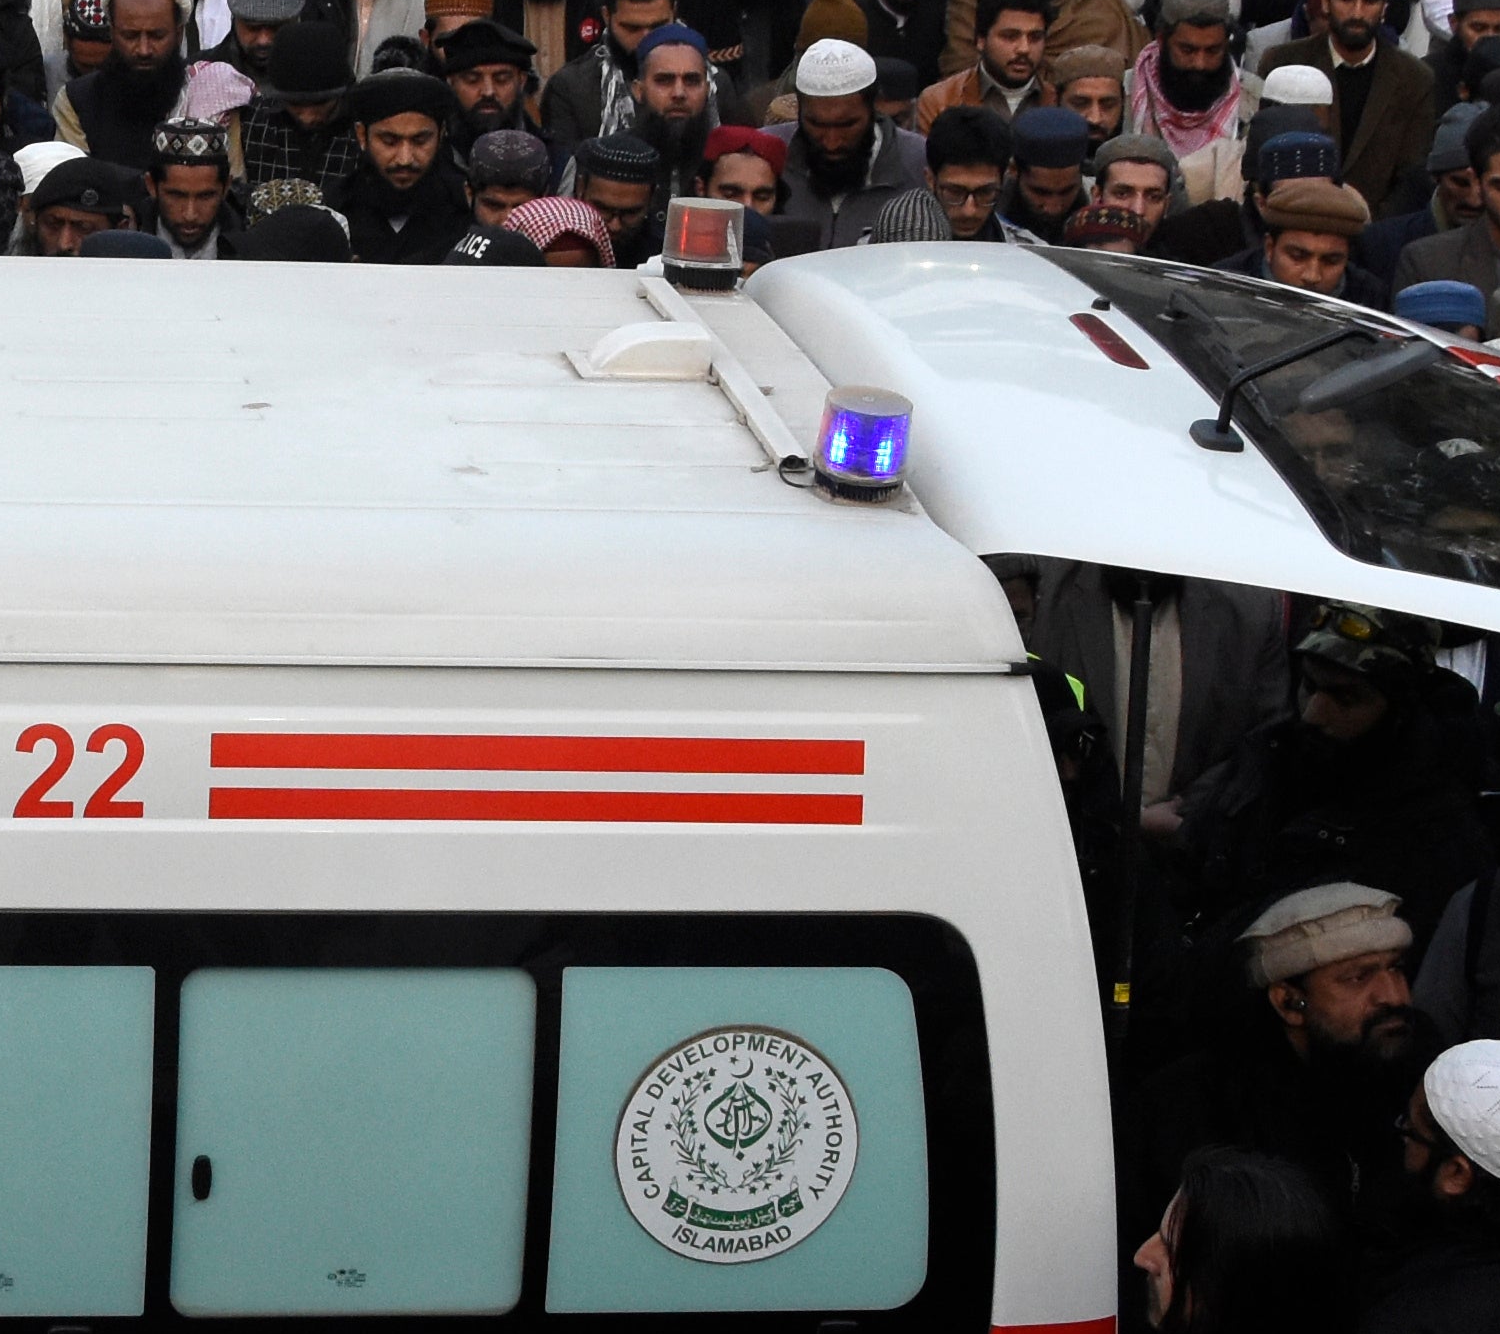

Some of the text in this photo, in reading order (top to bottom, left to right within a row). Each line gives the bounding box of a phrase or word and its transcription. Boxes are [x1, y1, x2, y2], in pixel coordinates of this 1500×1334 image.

[645, 1034, 812, 1100] DEVELOPMENT
[631, 1108, 661, 1199] CAPITAL
[805, 1070, 844, 1201] AUTHORITY
[671, 1223, 793, 1255] ISLAMABAD
